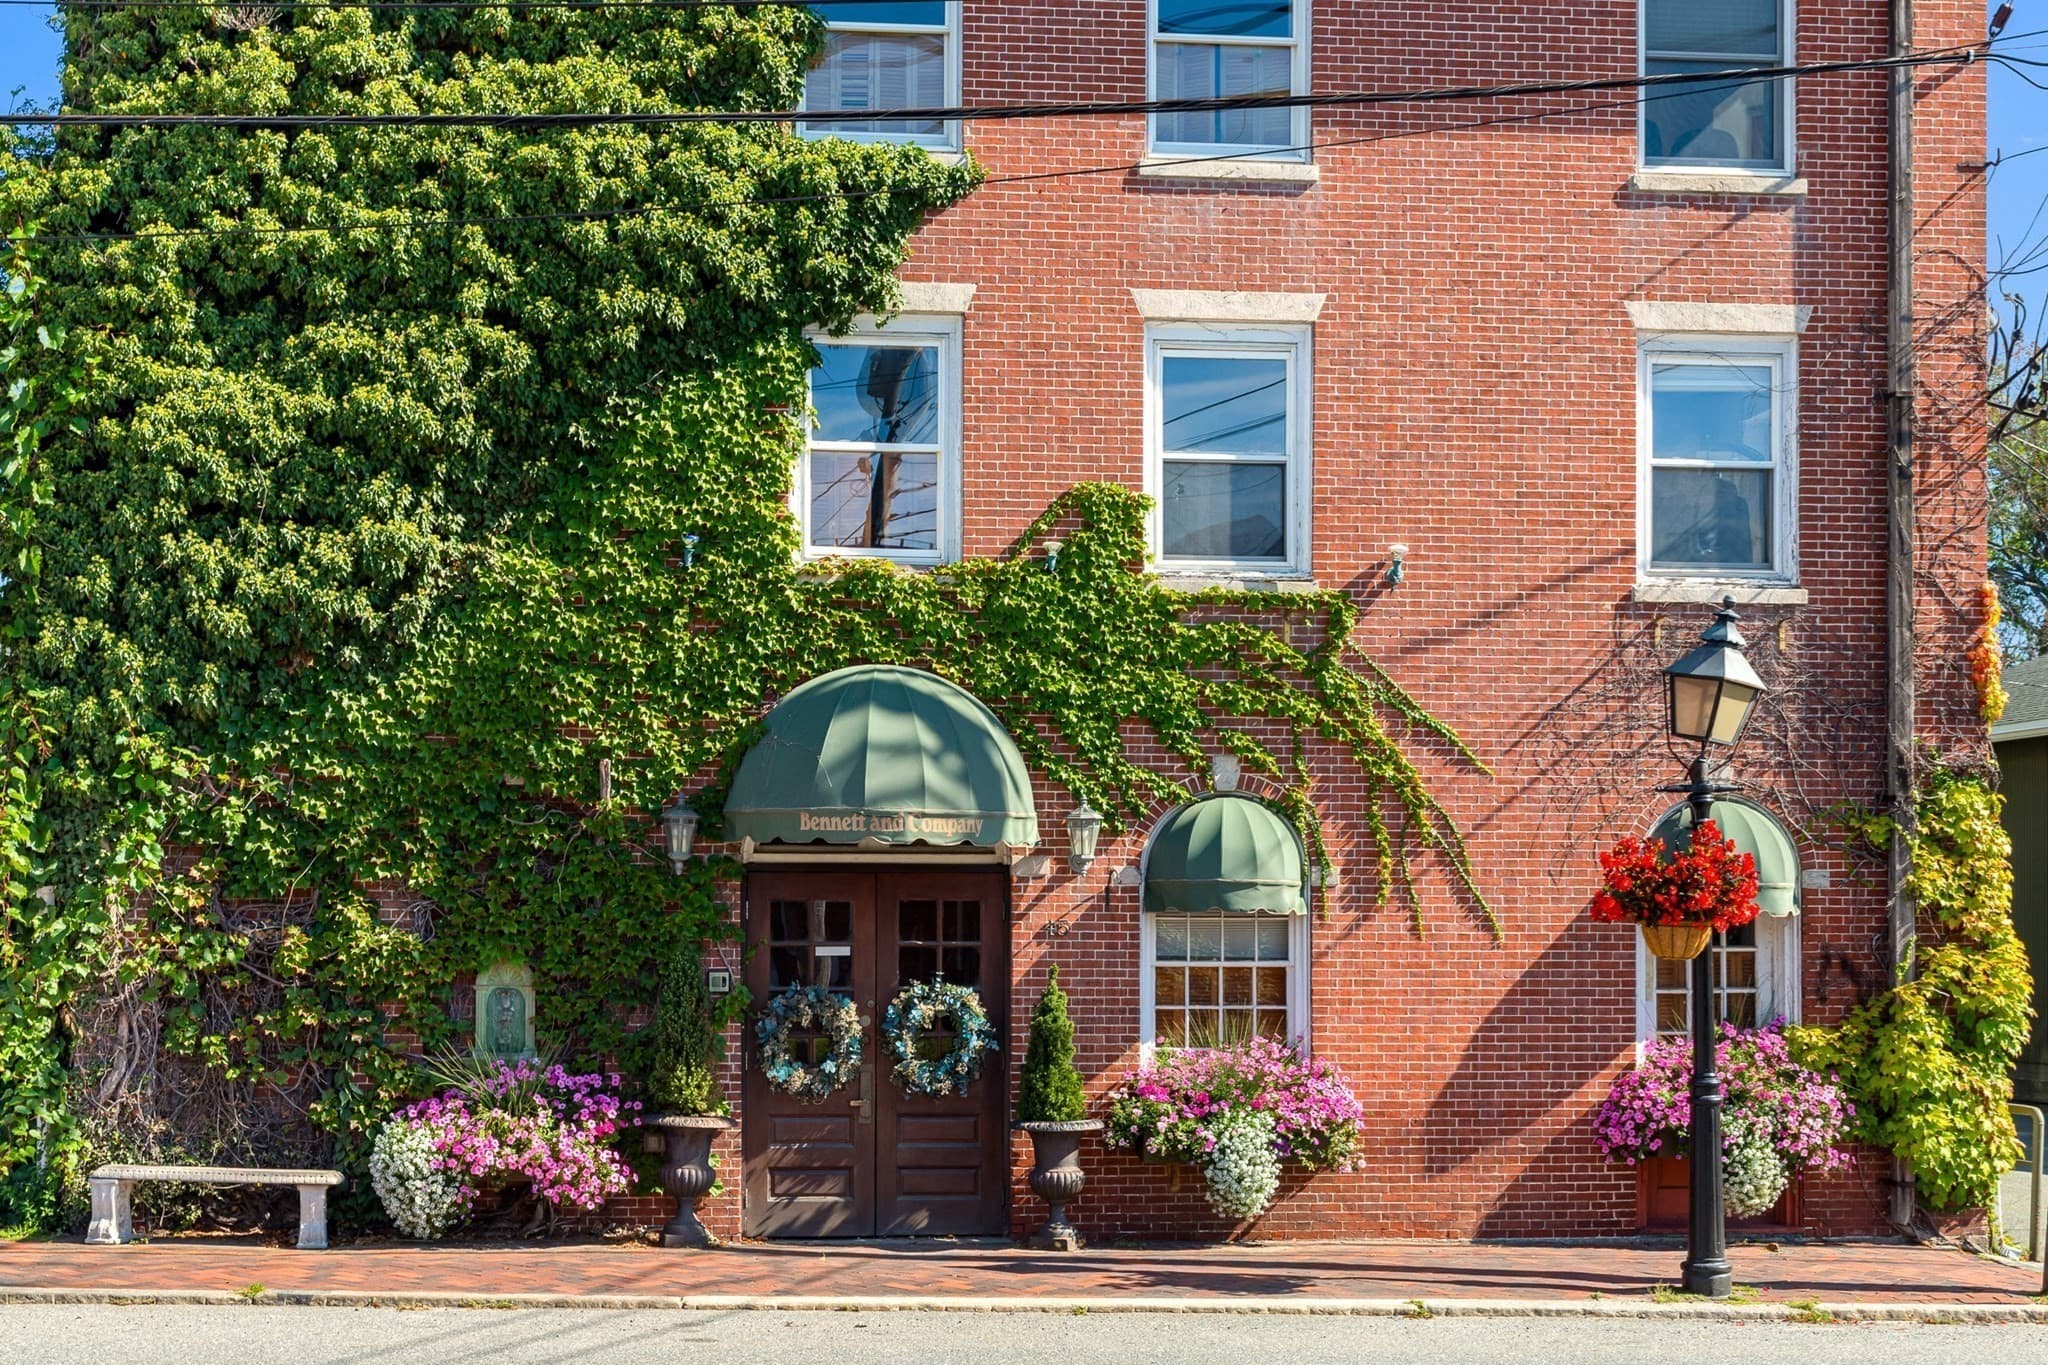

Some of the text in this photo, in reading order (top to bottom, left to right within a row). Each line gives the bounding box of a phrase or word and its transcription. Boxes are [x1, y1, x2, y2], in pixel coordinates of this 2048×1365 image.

[801, 812, 983, 837] Bennett and Company
